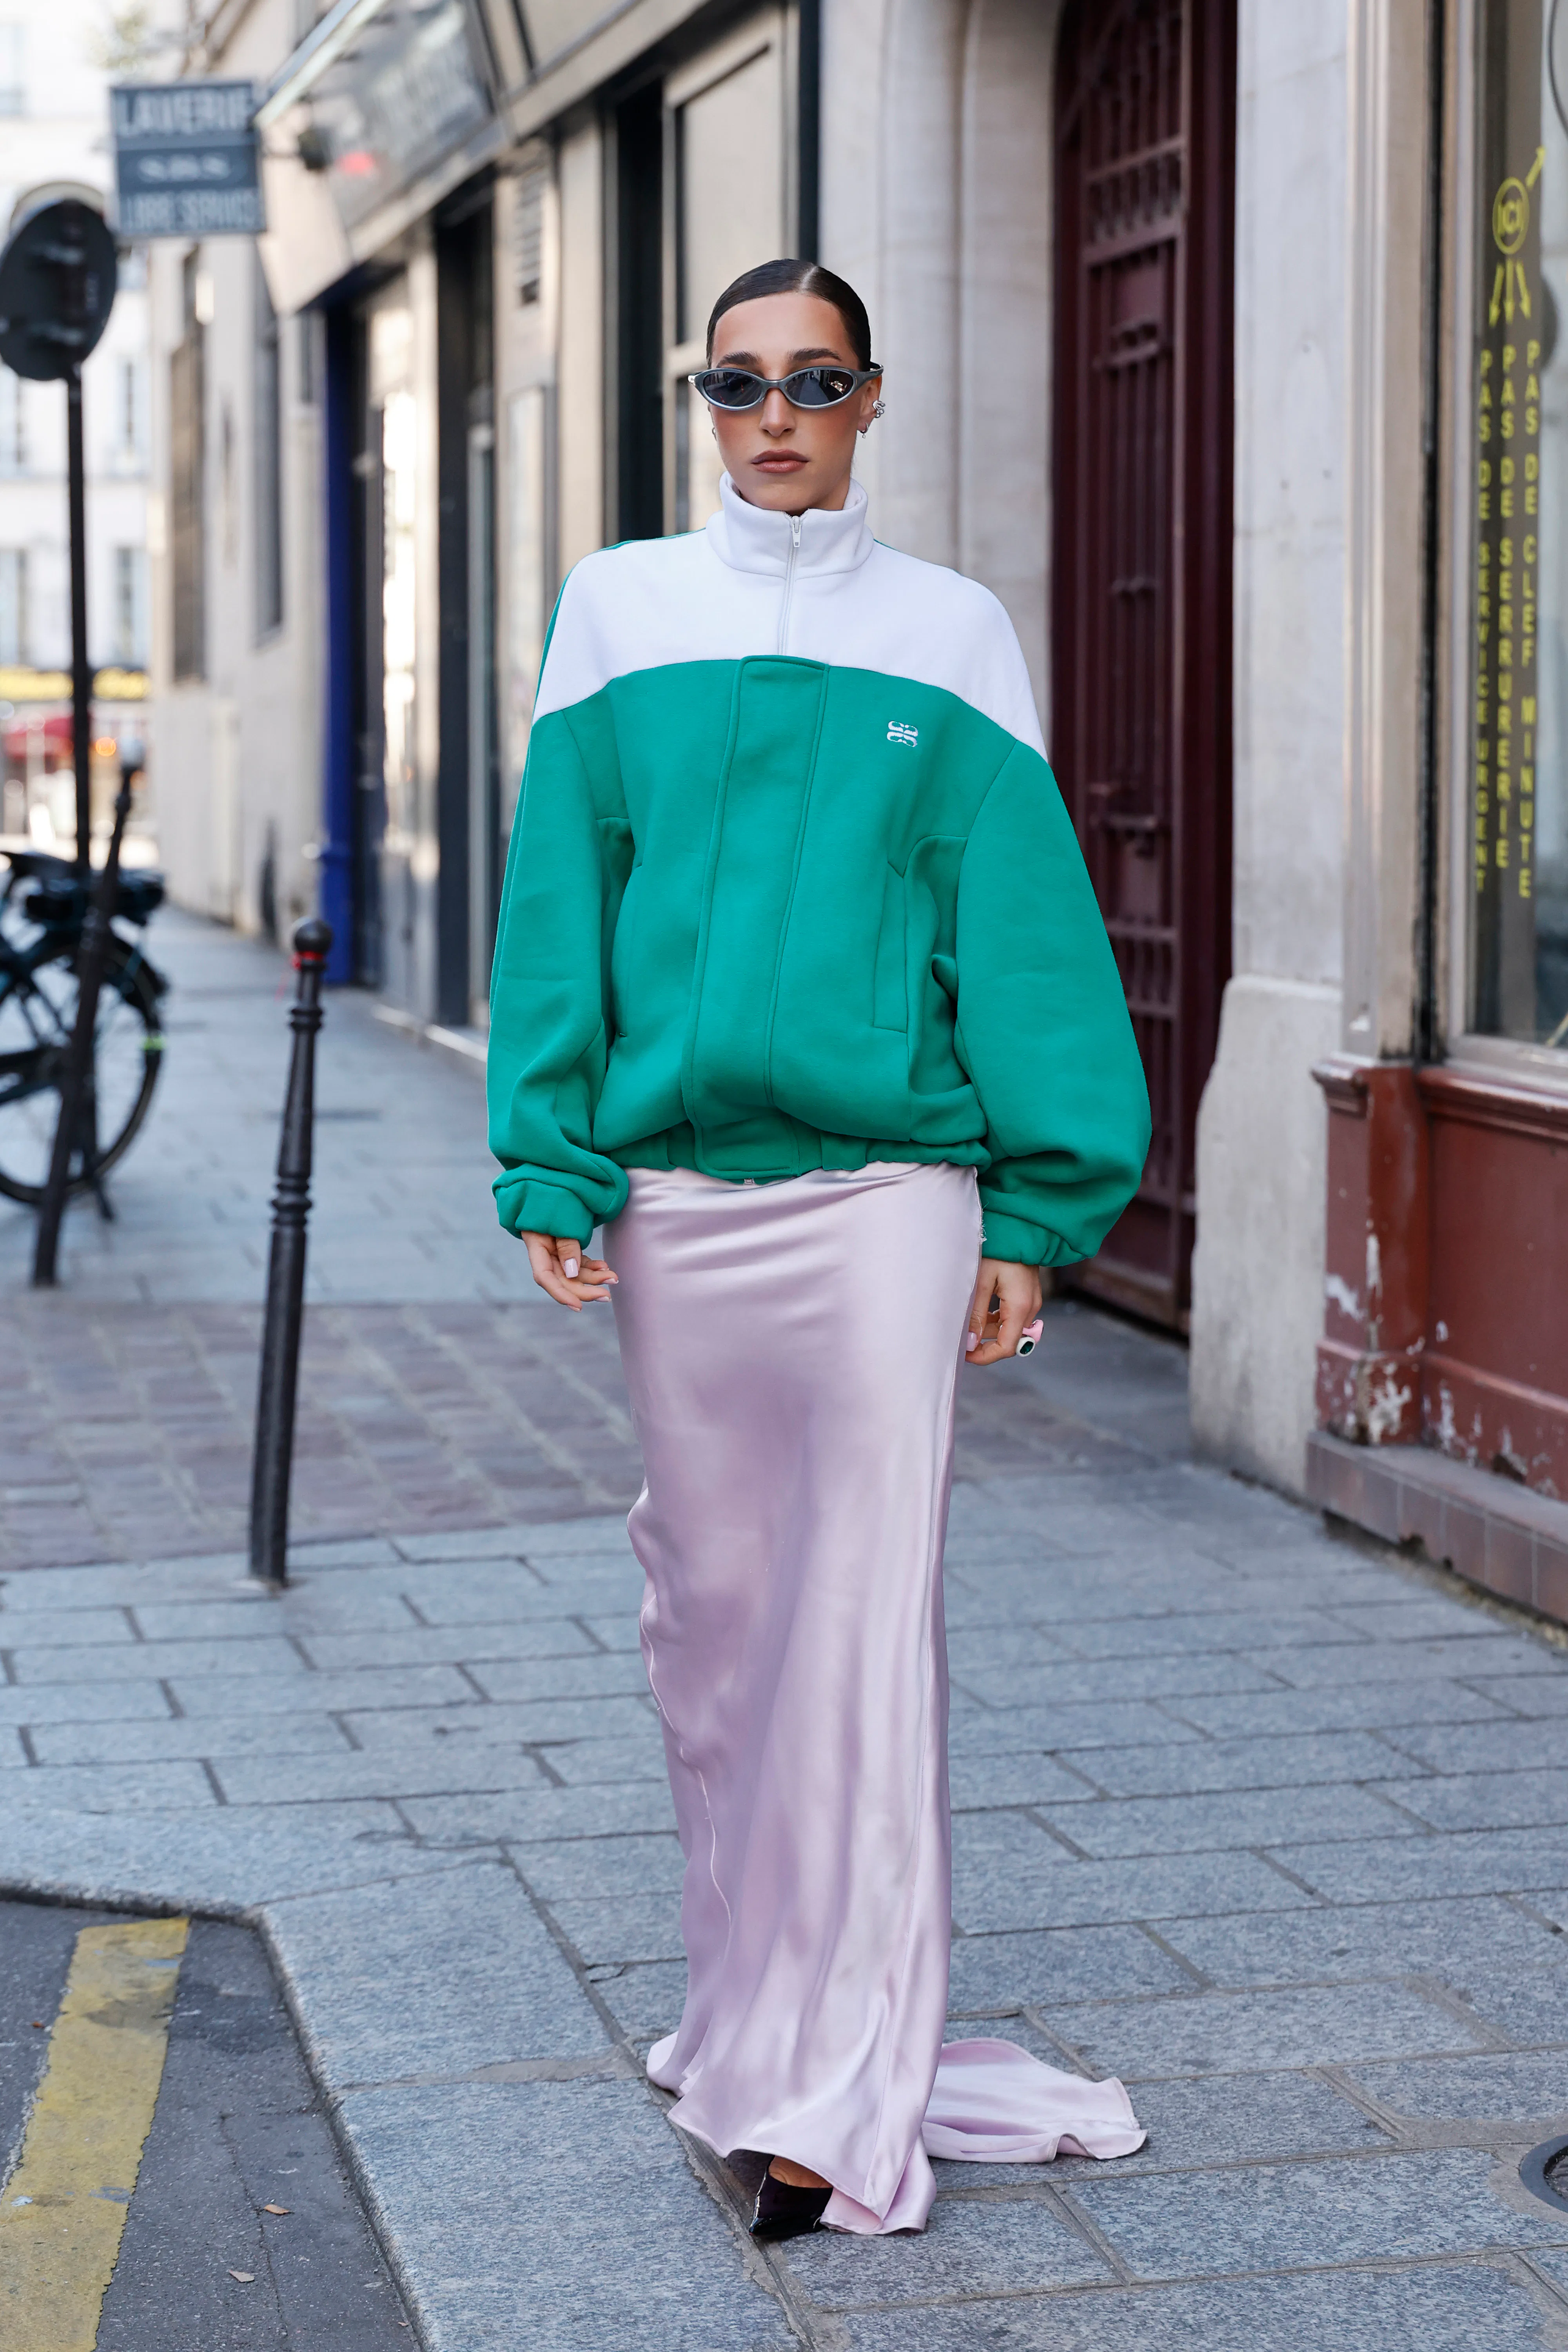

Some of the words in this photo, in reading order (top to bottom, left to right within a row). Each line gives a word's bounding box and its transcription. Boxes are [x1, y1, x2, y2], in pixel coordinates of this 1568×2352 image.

[1479, 348, 1492, 443] PAS
[1501, 344, 1517, 439] PAS
[1525, 339, 1541, 435] PAS
[1478, 459, 1491, 520] DE
[1500, 456, 1515, 518] DE
[1524, 453, 1539, 515] DE
[1477, 542, 1490, 724] SERVICE
[1522, 534, 1537, 668] CLEF
[1496, 537, 1514, 868] SERRURERIE
[1475, 739, 1489, 891] URGENT
[1519, 697, 1537, 898] MINUTE
